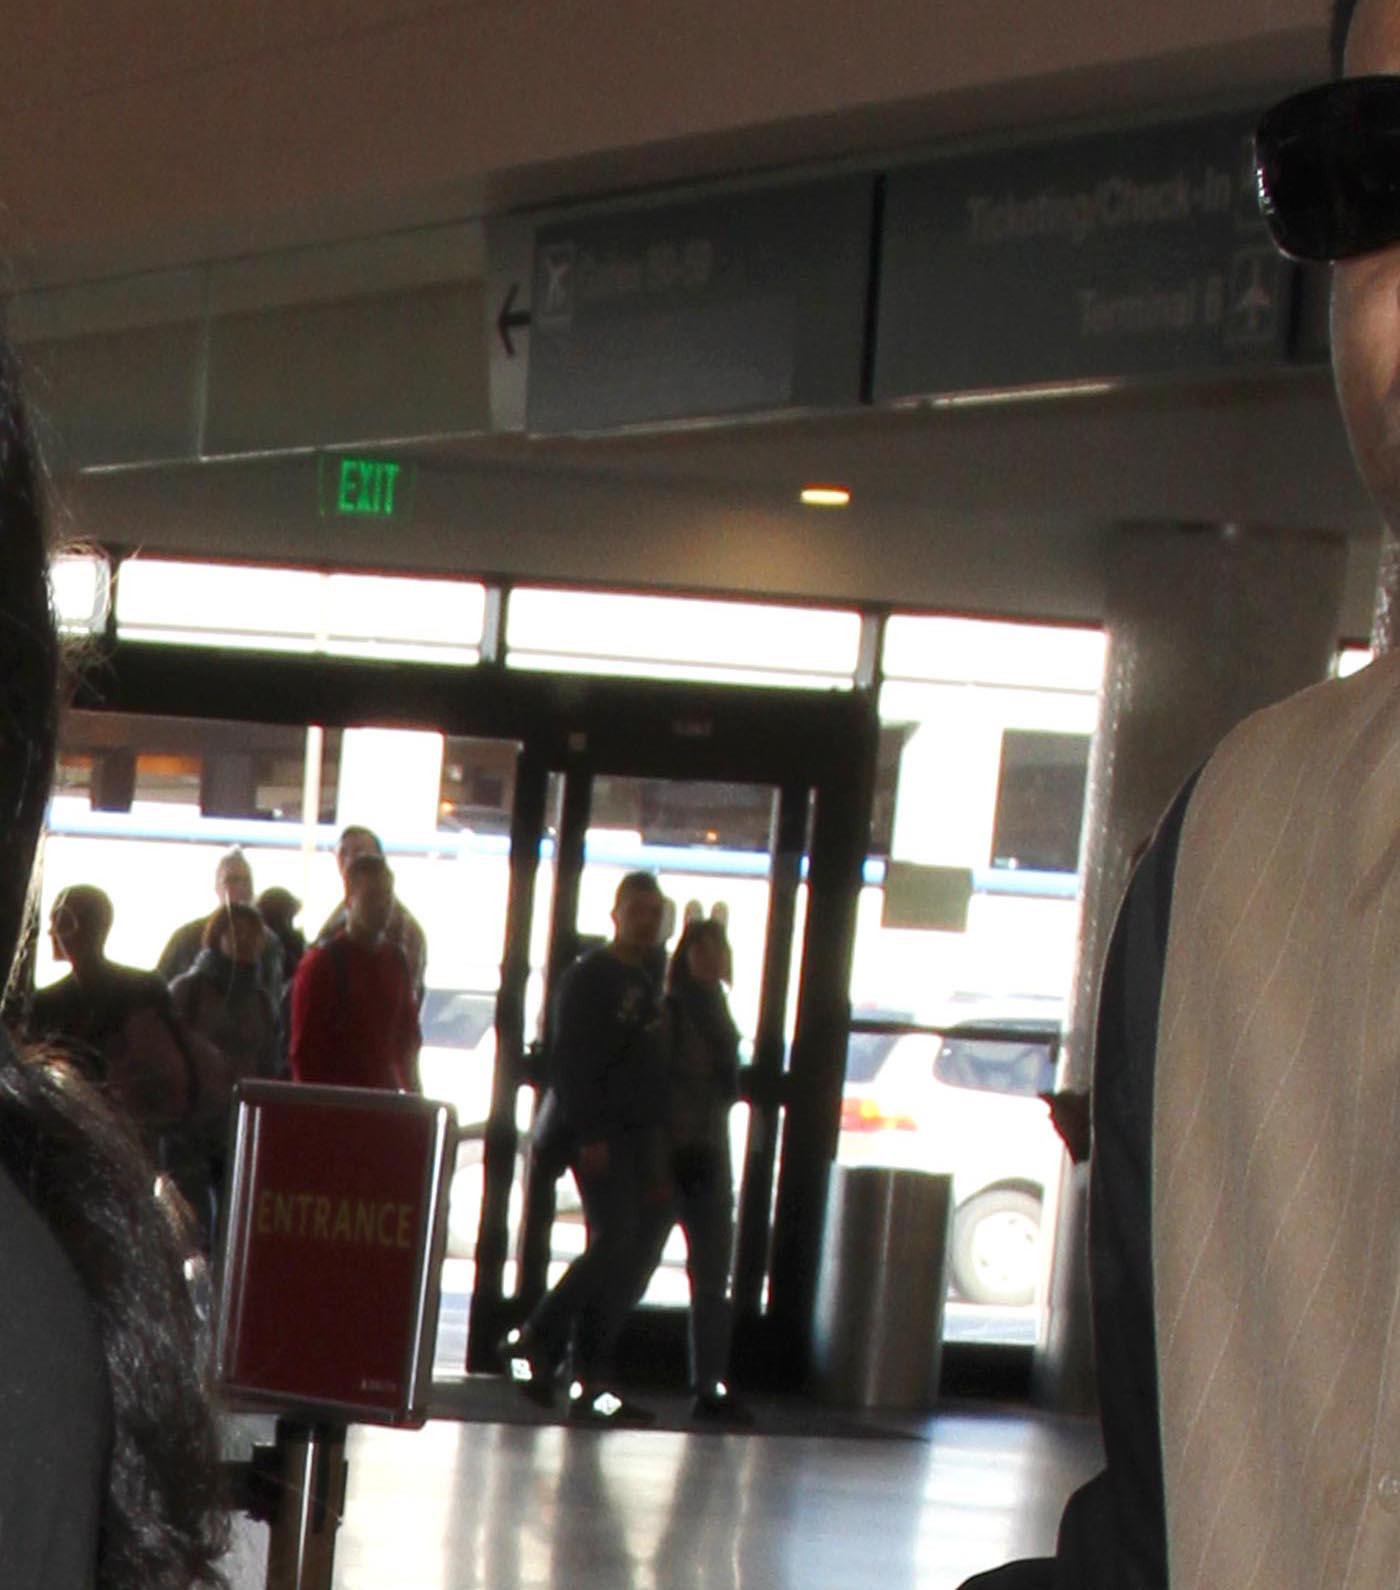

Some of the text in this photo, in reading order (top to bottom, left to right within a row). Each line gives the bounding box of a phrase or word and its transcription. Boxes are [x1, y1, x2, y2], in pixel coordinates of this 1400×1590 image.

[1077, 279, 1196, 335] Terminal
[339, 459, 400, 515] EXIT
[256, 1190, 415, 1249] ENTRANCE
